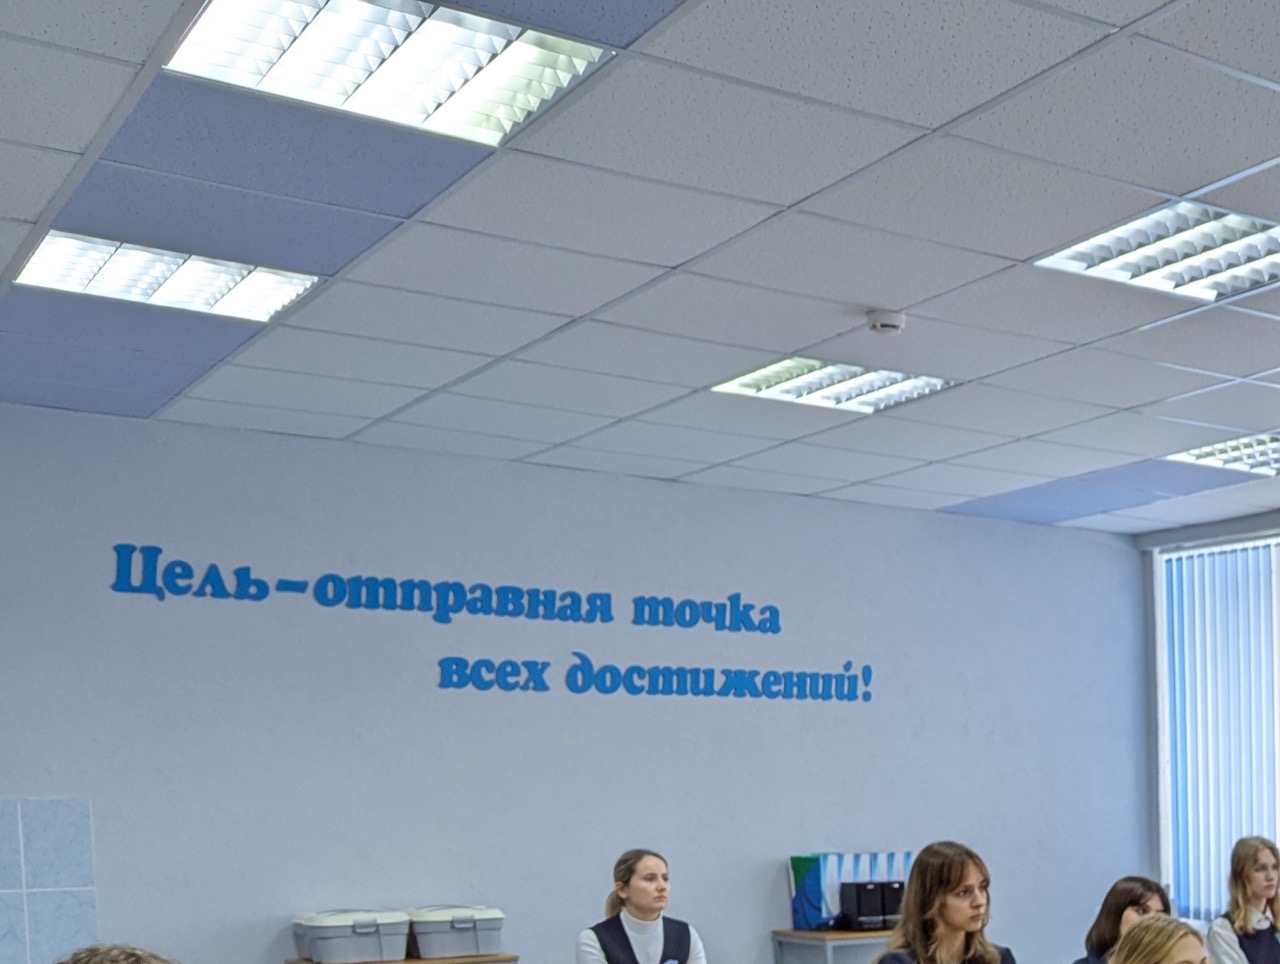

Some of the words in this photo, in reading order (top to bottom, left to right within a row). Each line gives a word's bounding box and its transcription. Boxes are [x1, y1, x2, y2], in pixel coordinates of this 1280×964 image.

[632, 592, 782, 635] точка
[438, 655, 550, 693] всех
[566, 651, 873, 703] достижений!
